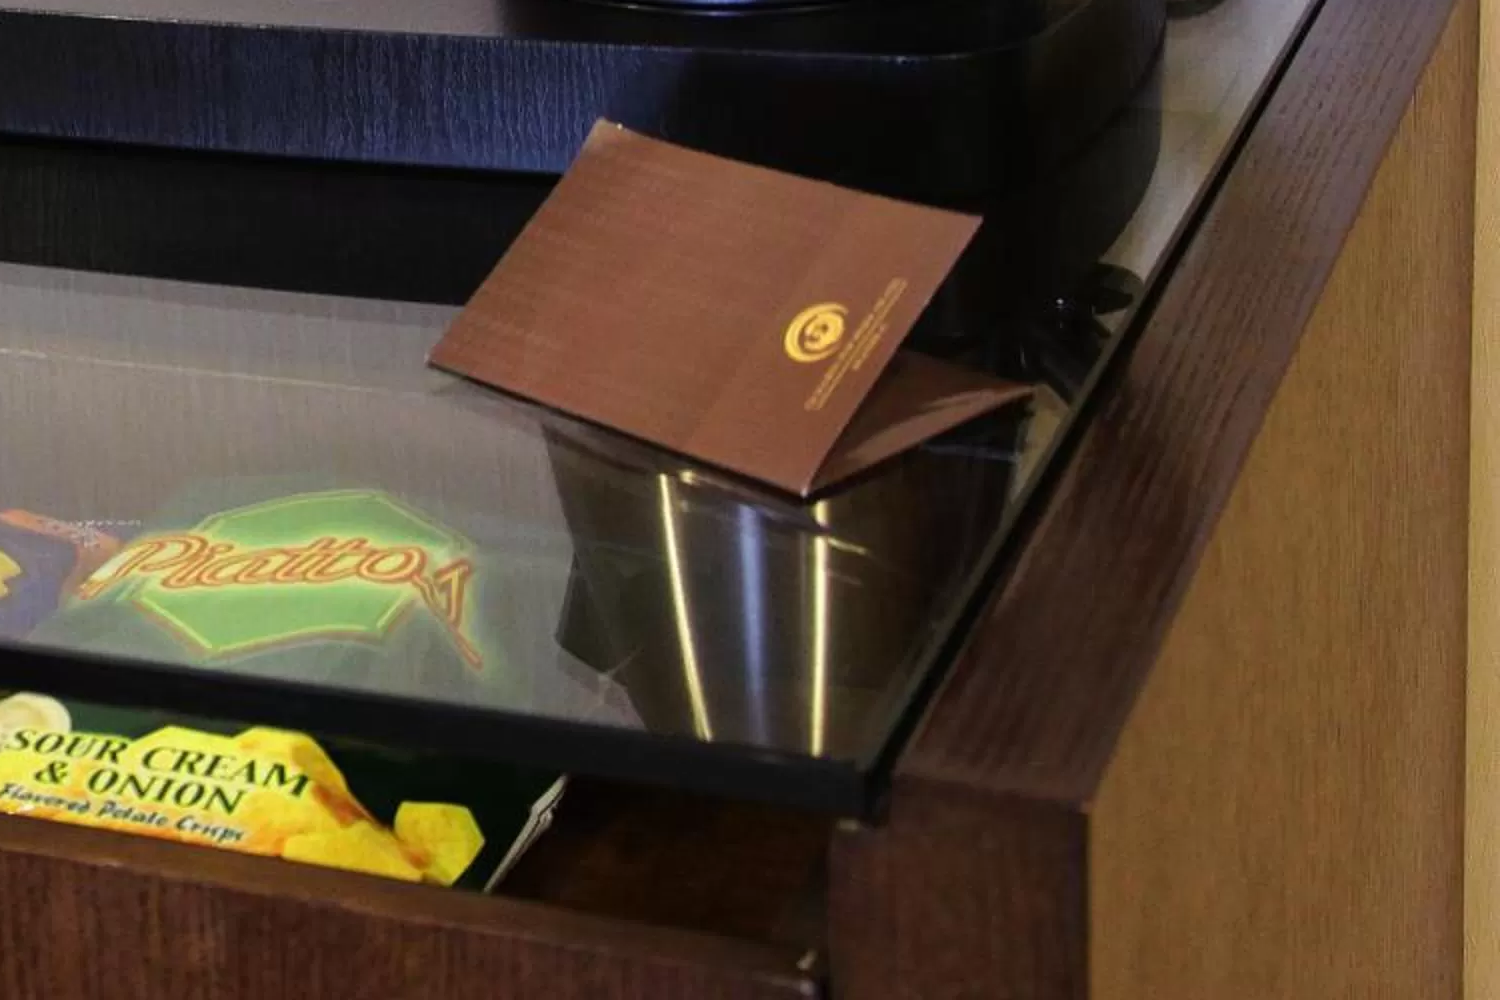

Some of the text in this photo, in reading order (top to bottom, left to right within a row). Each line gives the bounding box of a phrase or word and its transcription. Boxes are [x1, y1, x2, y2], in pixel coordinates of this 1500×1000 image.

[78, 533, 485, 671] Piattos
[4, 728, 312, 798] SOUR CREAM
[32, 760, 248, 816] & ONION
[97, 799, 171, 829] Potato
[175, 814, 246, 843] Crisps
